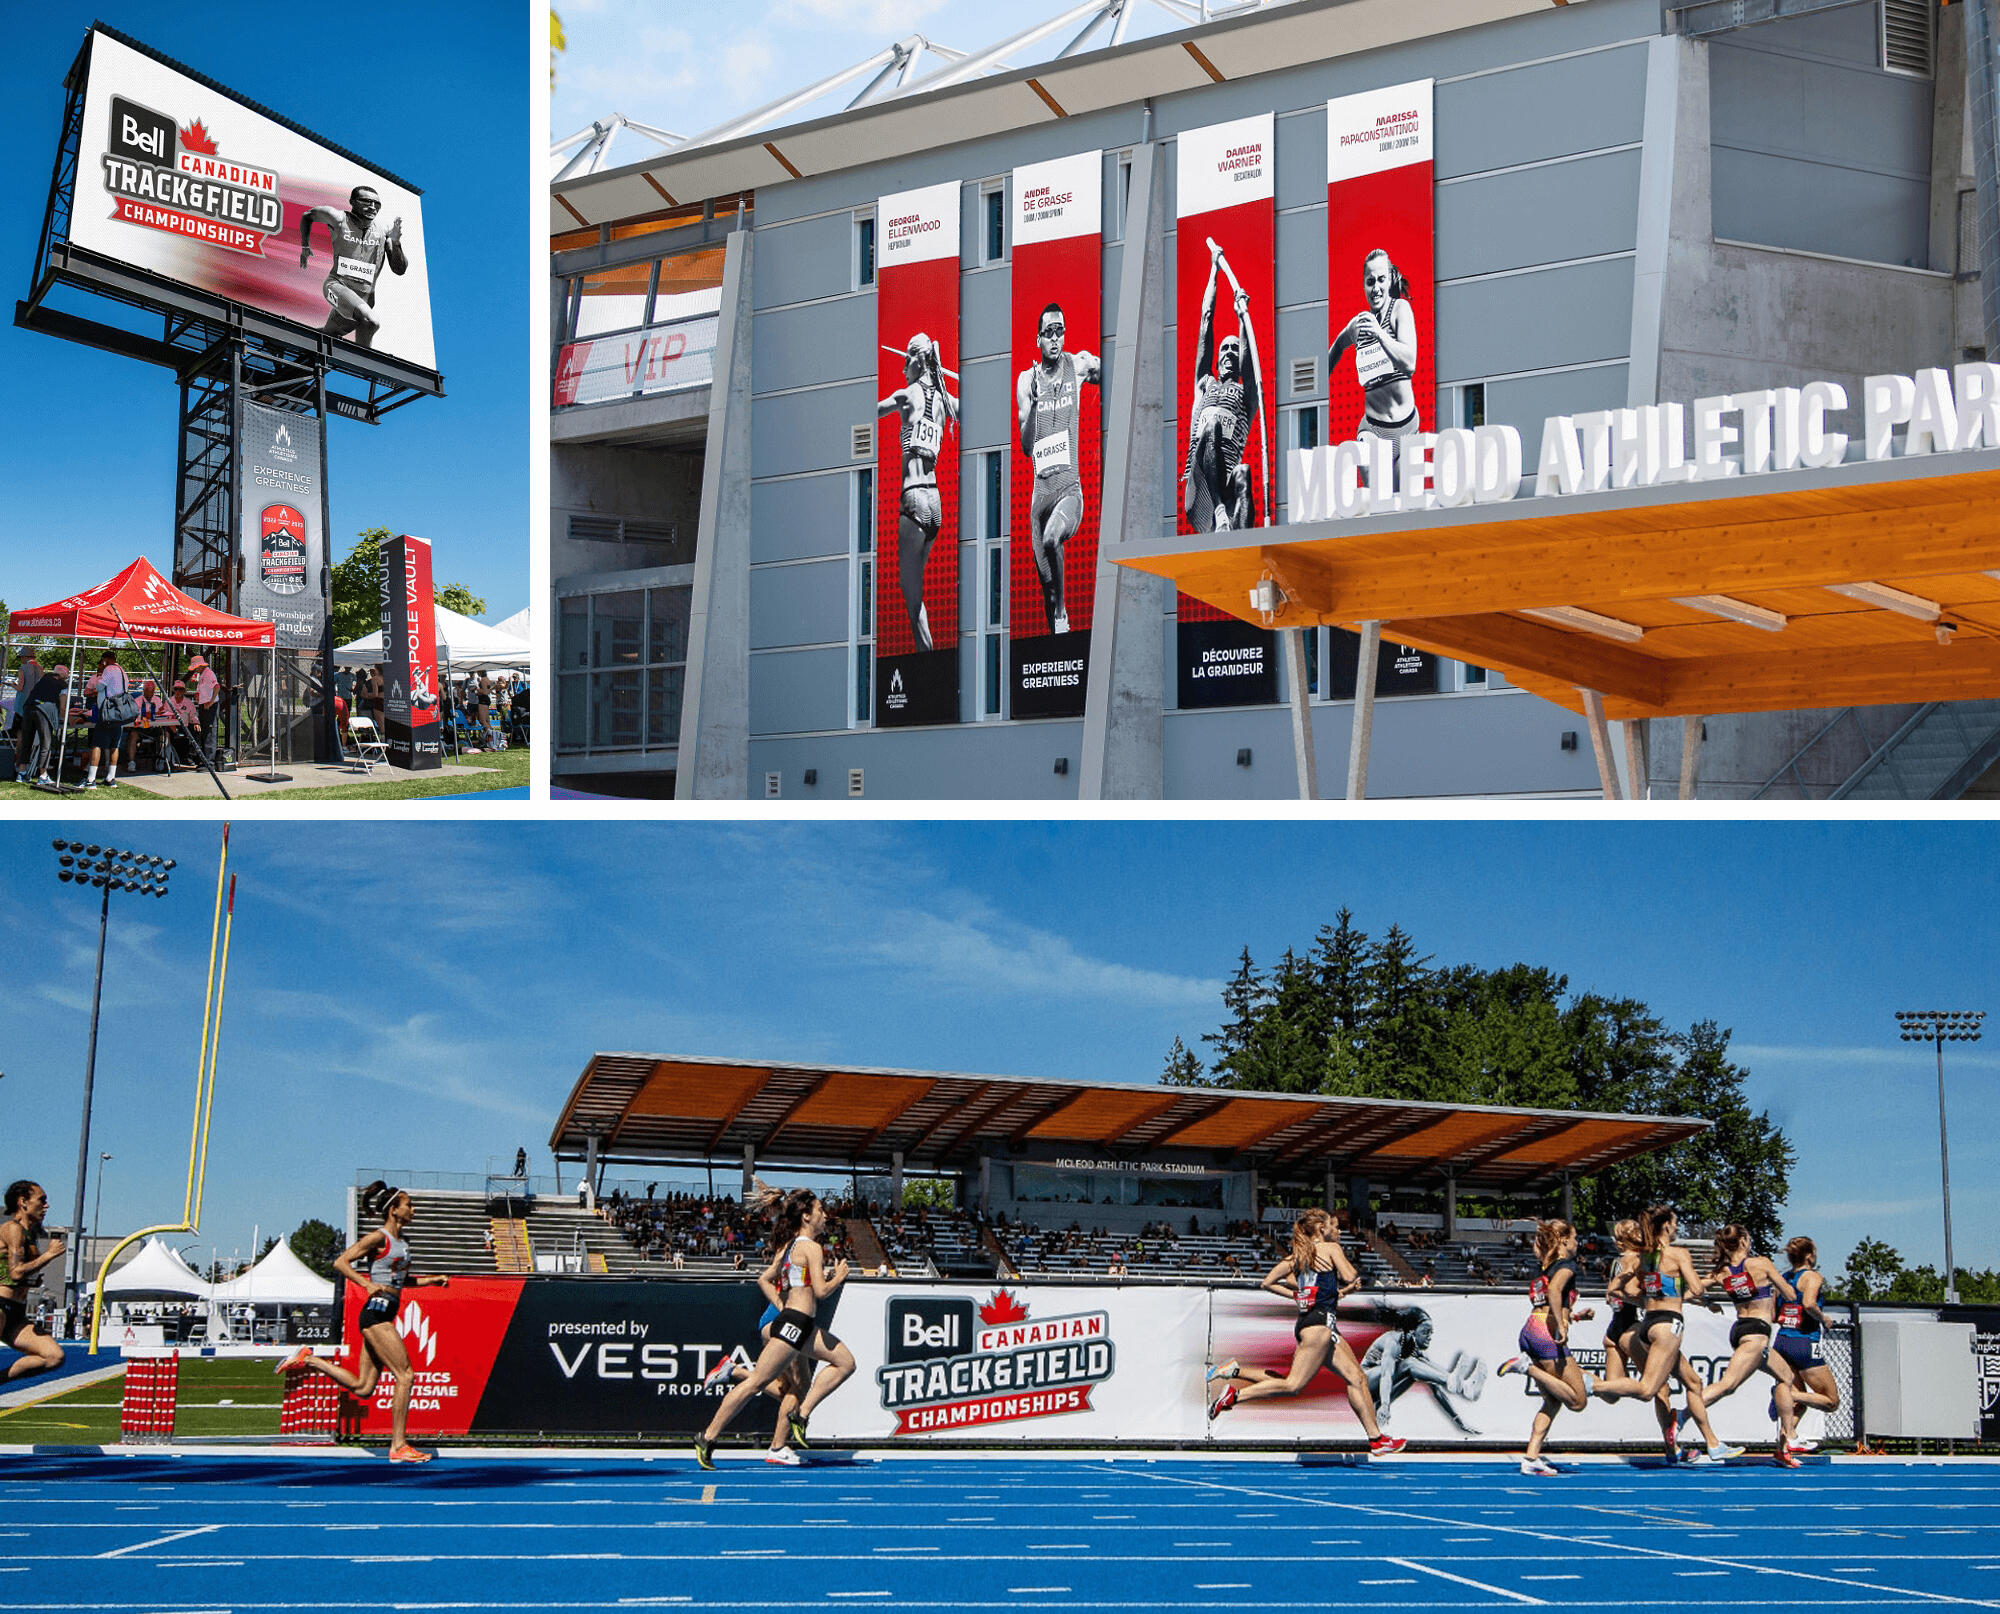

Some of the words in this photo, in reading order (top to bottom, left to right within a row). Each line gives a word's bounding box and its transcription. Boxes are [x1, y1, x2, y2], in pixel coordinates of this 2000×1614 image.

[1376, 110, 1418, 126] MARISSA
[122, 114, 165, 158] Bell
[1340, 121, 1419, 146] PAPACONSTANTINOU
[1226, 143, 1262, 158] DAMIAN
[1217, 154, 1262, 172] WARNER
[181, 155, 273, 190] CANADIAN
[106, 159, 278, 228] TRACK&FIELD
[1024, 186, 1050, 199] ANDRE
[1024, 200, 1036, 211] DE
[1038, 192, 1072, 208] GRASSE
[124, 203, 255, 249] CHAMPIONSHIPS
[888, 214, 920, 228] GEORGIA
[888, 220, 941, 240] ELLENWOOD
[343, 234, 380, 246] CANADA
[624, 333, 687, 385] VIP
[1037, 396, 1073, 412] CANADA
[916, 420, 938, 446] 1391
[1043, 442, 1068, 457] GRASSE
[1286, 425, 1522, 525] MCLEOD
[1534, 381, 1849, 497] ATHLETIC
[254, 465, 312, 485] EXPERIENCE
[256, 476, 310, 495] GREATNESS
[278, 538, 290, 548] Bell
[262, 557, 306, 566] TRACK&FIELD
[379, 548, 391, 607] VAULT
[404, 543, 418, 605] VAULT
[272, 610, 306, 621] Township
[120, 623, 243, 639] www.athletics.ca
[272, 618, 314, 636] Langley
[381, 611, 392, 663] POLE
[407, 610, 420, 664] POLE
[1202, 646, 1263, 662] DÉCOUVREZ
[1022, 659, 1084, 674] EXPERIENCE
[1192, 666, 1205, 678] LA
[1207, 662, 1264, 677] GRANDEUR
[1022, 674, 1080, 689] GREATNESS
[1056, 1158, 1095, 1170] MCLEOD
[1096, 1160, 1138, 1172] ATHLETIC
[1140, 1161, 1164, 1173] PARK
[1164, 1163, 1205, 1175] STADIUM
[296, 1327, 330, 1338] 2:23.5
[548, 1320, 626, 1337] presented
[630, 1320, 649, 1338] by
[786, 1326, 798, 1340] 10
[902, 1313, 960, 1347] Bell
[982, 1317, 1101, 1350] CANADIAN
[548, 1342, 757, 1380] VESTA
[882, 1343, 1109, 1403] TRACK&FIELD
[376, 1398, 441, 1411] CAADA
[908, 1390, 1080, 1430] CHAMPIONSHIPS
